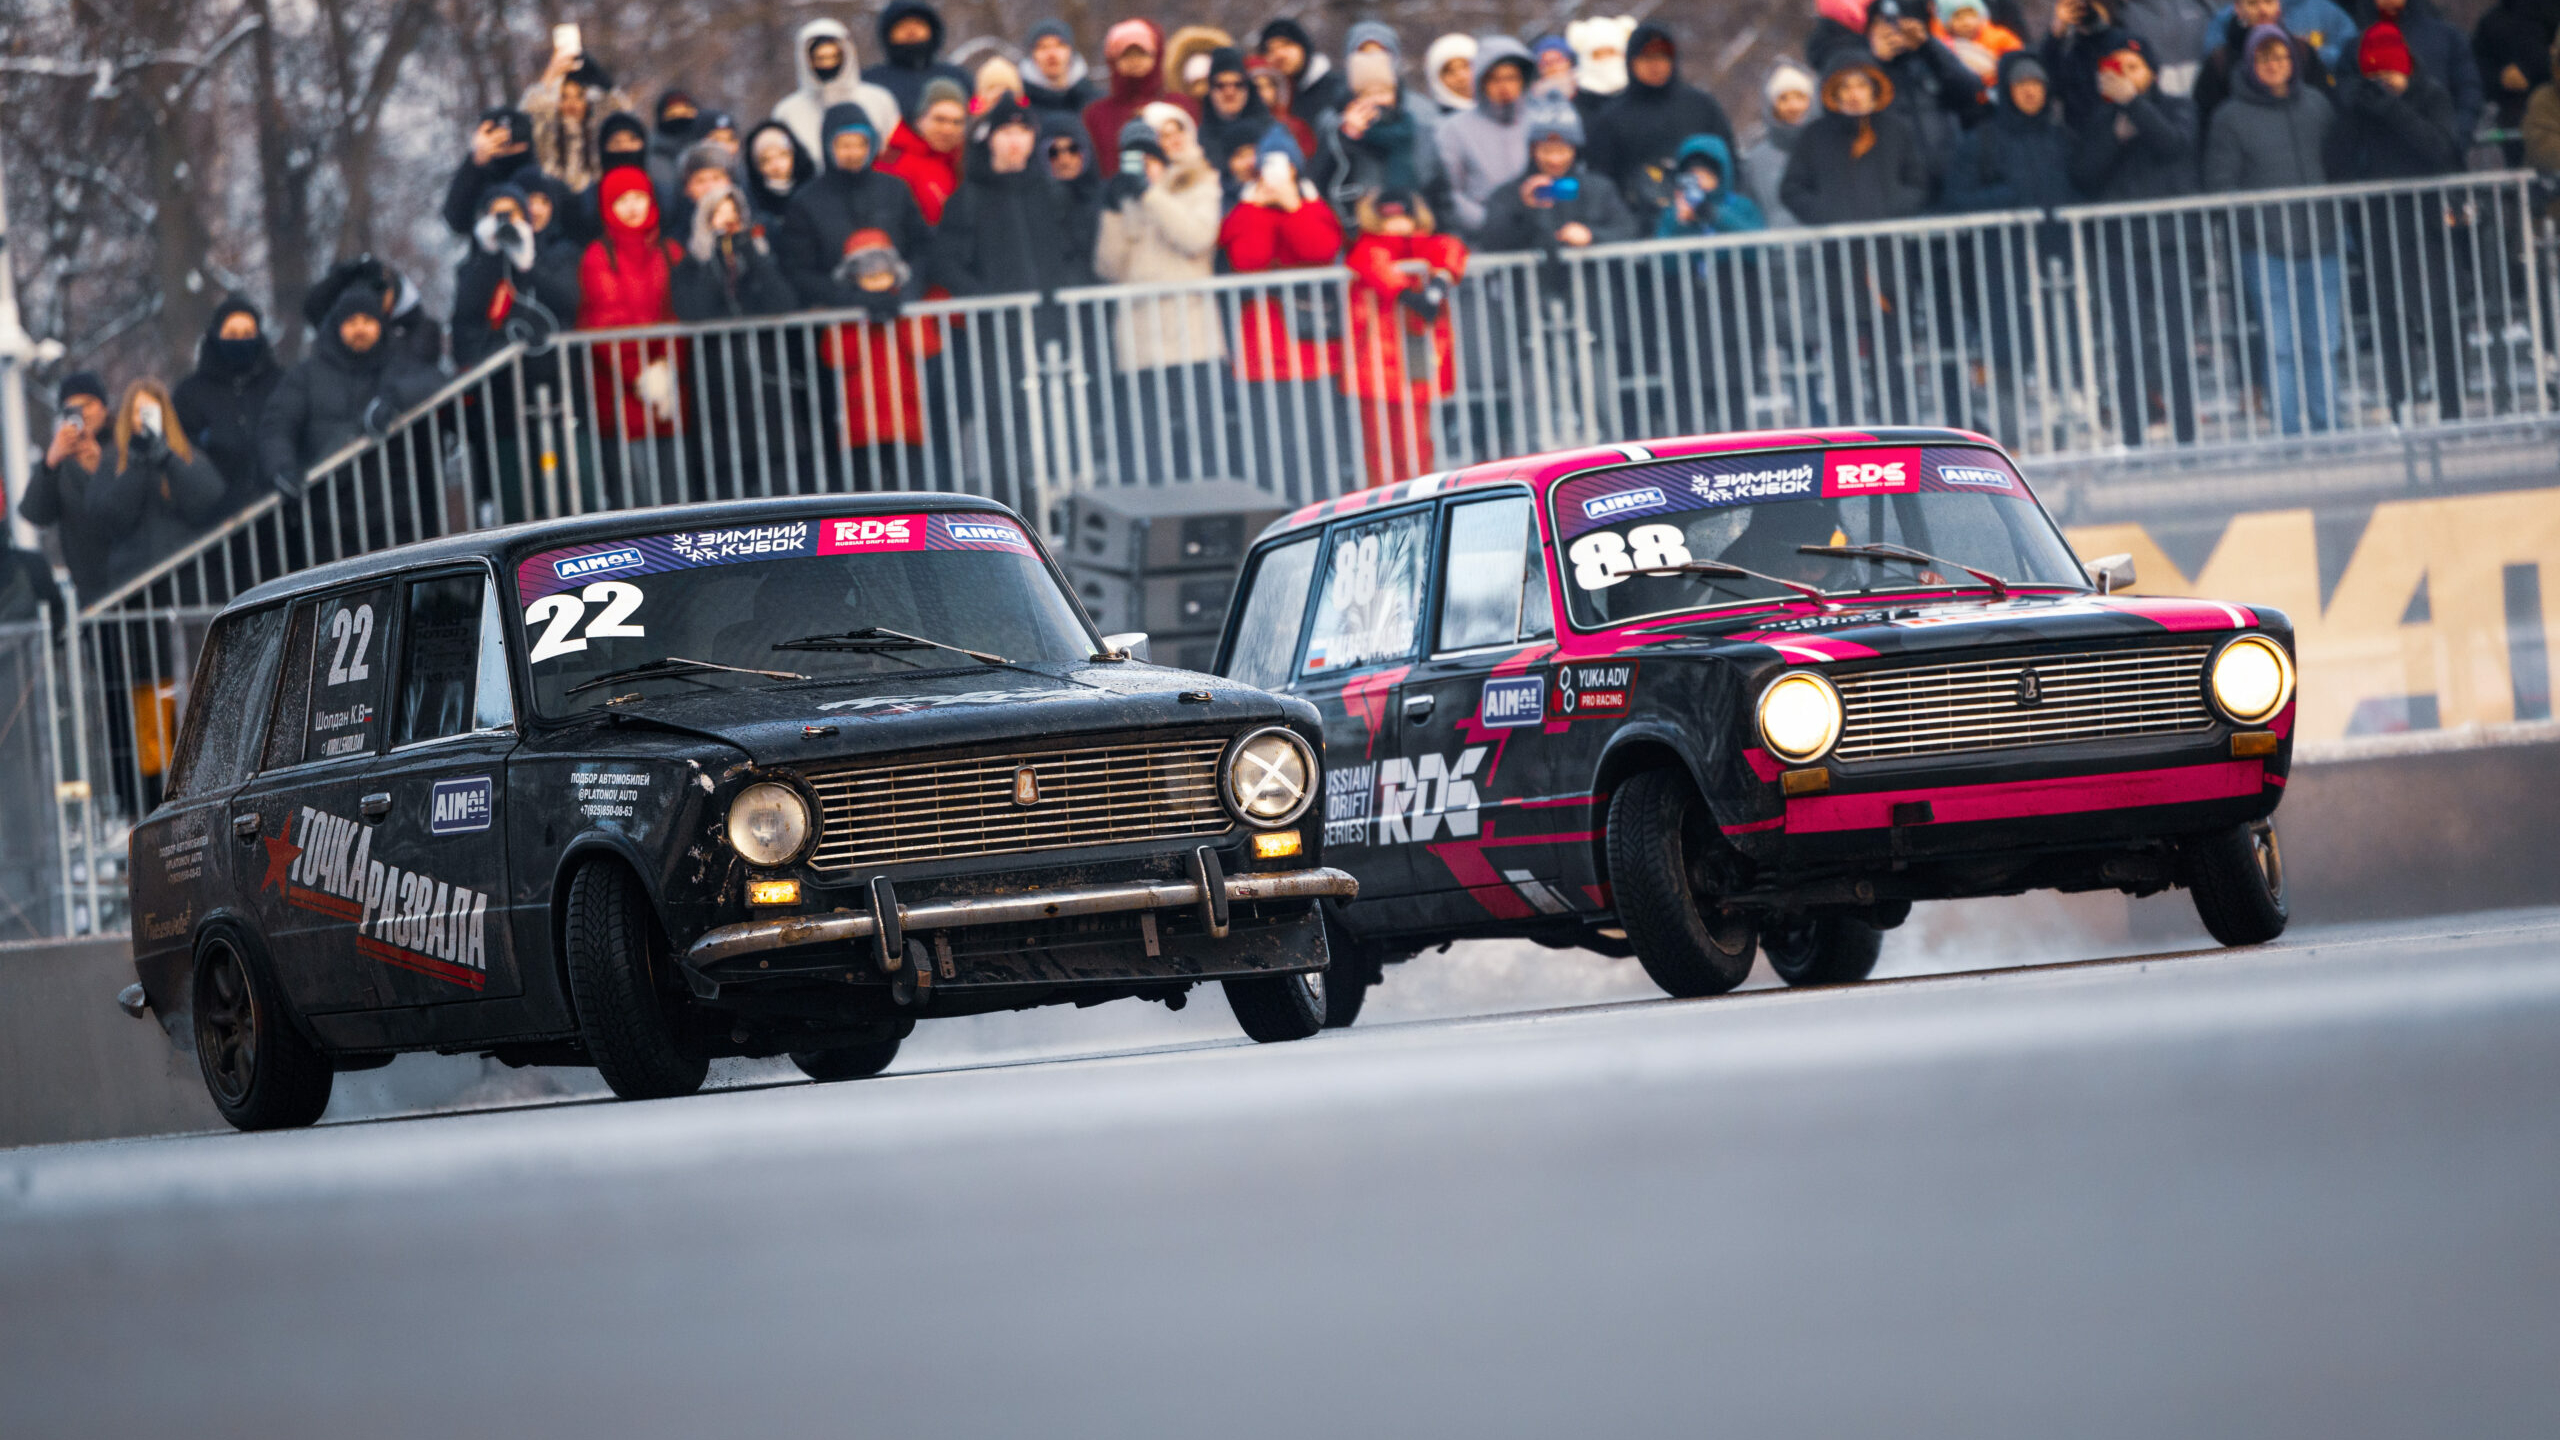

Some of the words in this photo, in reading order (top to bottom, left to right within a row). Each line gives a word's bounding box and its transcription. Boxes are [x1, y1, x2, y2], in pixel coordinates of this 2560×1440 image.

[1713, 464, 1813, 487] ЗИМНИЙ
[1836, 462, 1905, 484] RDS
[1946, 469, 2006, 483] AIMOL
[1735, 480, 1811, 498] КУБОК
[1589, 491, 1661, 516] AIMOL
[697, 522, 808, 546] ЗИМНИЙ
[834, 519, 910, 541] RDS
[954, 526, 1022, 543] AIMOL
[721, 537, 805, 557] КУБОК
[1569, 524, 1692, 590] 88
[561, 550, 641, 576] AIMOL
[1332, 534, 1379, 612] 88
[525, 581, 645, 664] 22
[328, 603, 374, 687] 22
[1578, 668, 1605, 687] YUKA
[1606, 667, 1630, 687] ADV
[1485, 688, 1540, 717] AIMOL
[1582, 695, 1596, 707] PRO
[1596, 694, 1622, 706] RACING
[315, 711, 349, 731] Шолдан
[570, 773, 598, 785] ПОДБОР
[599, 772, 650, 786] АВТОМОБИЛЕЙ
[1326, 765, 1371, 795] USSIAN
[434, 790, 489, 823] AIMOL
[1329, 790, 1368, 820] DRIFT
[1379, 746, 1489, 846] RDS
[291, 806, 373, 902] ТОЧКА
[359, 859, 488, 970] РАЗВАЛА
